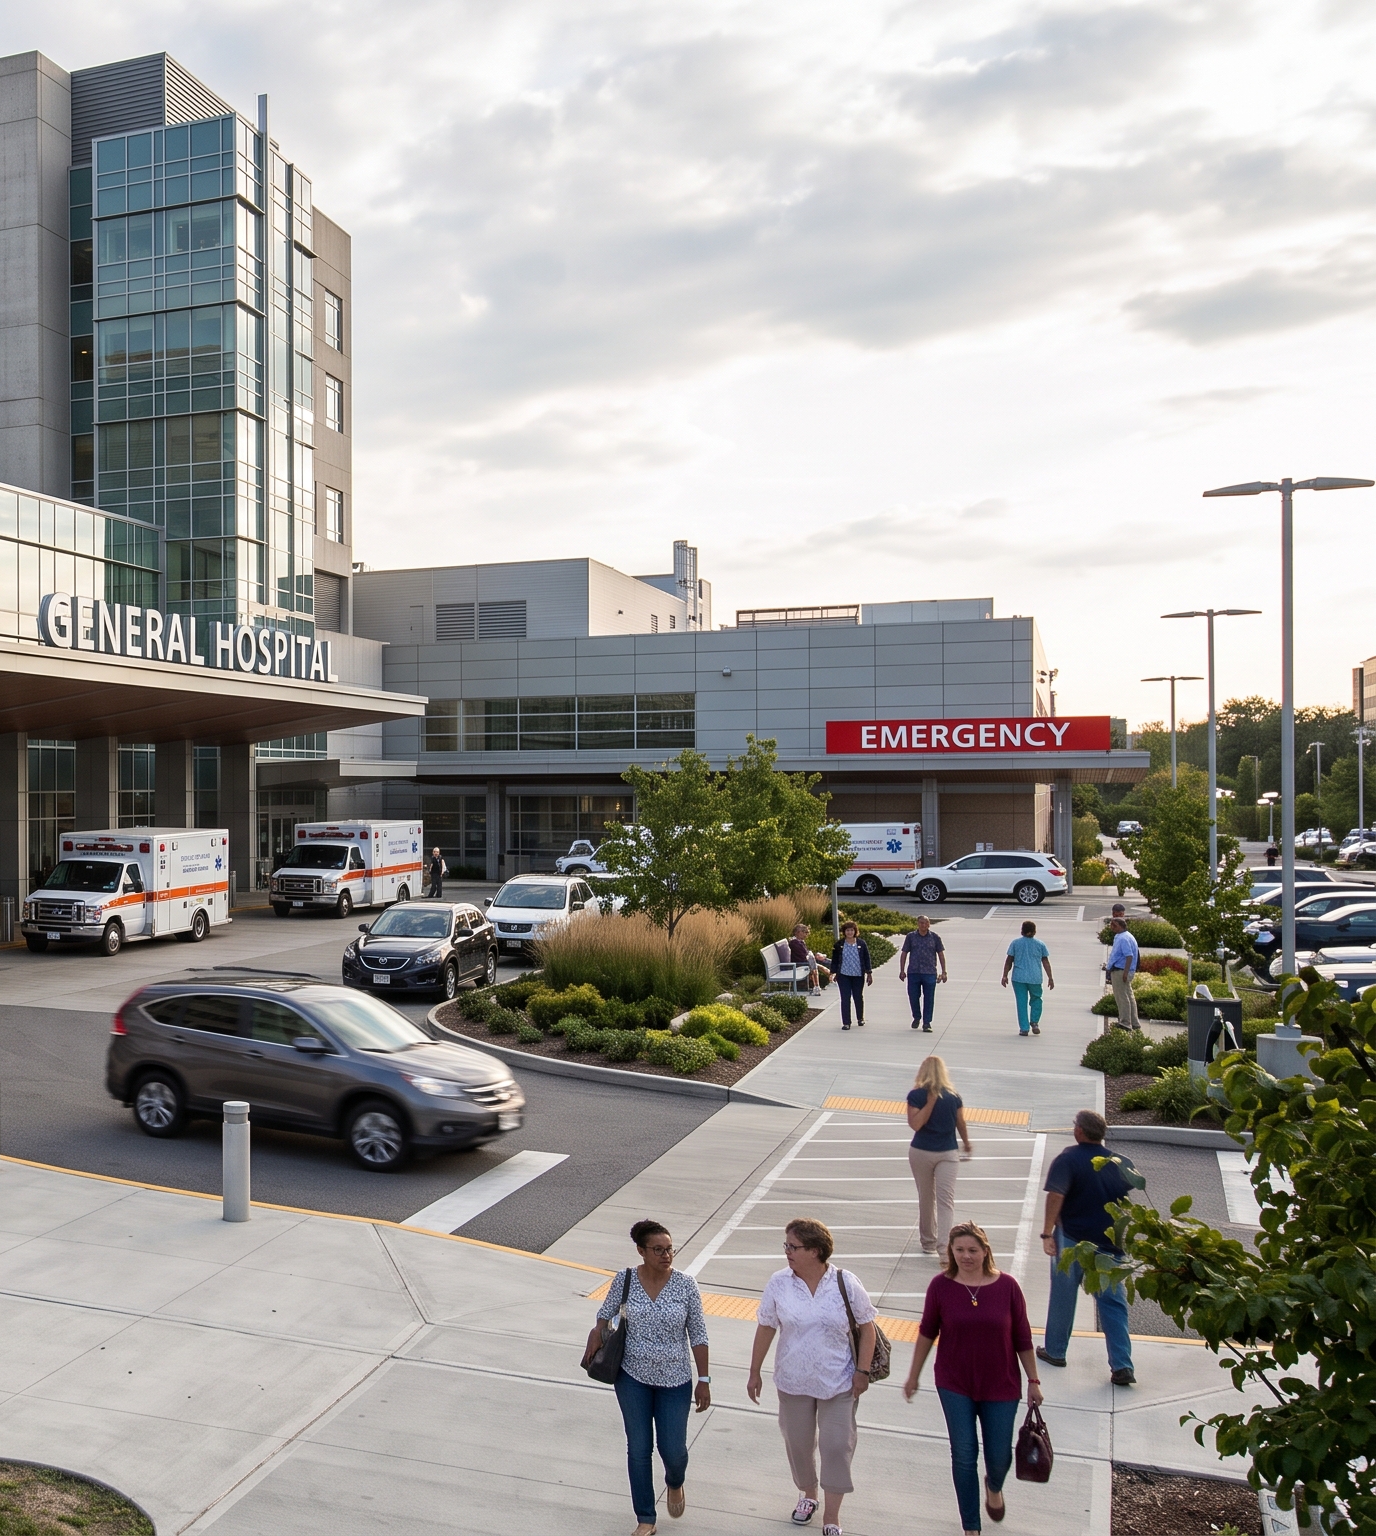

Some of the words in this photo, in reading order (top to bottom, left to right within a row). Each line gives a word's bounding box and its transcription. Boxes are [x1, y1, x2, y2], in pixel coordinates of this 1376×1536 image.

[40, 592, 204, 665] GENERAL
[211, 621, 339, 682] HOSPITAL
[861, 722, 1070, 749] EMERGENCY
